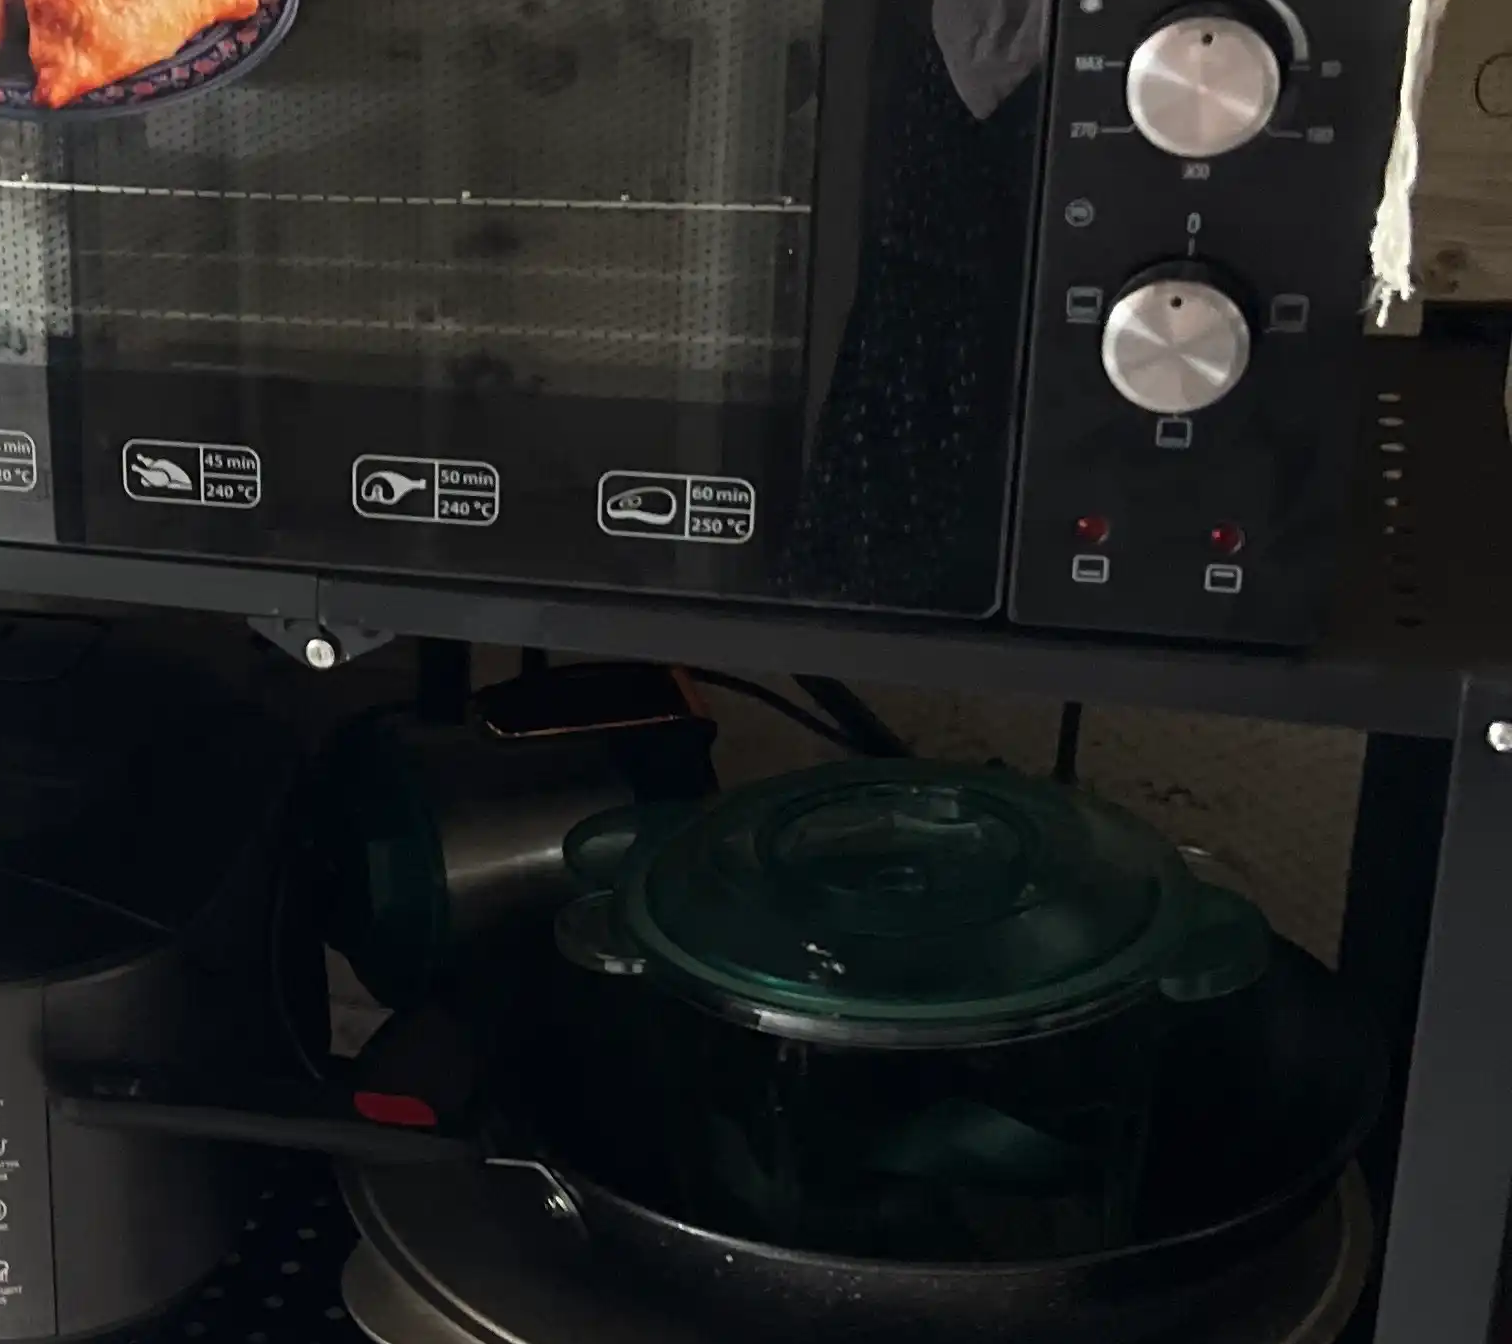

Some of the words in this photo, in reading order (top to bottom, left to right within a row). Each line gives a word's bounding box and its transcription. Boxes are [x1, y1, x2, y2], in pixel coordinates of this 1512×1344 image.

[5, 440, 32, 456] min
[204, 453, 223, 471] 45
[226, 455, 256, 472] min
[440, 469, 461, 486] 50
[462, 471, 494, 487] min
[205, 483, 234, 502] 240
[691, 484, 713, 502] 60
[715, 488, 750, 504] min
[439, 498, 470, 517] 240
[690, 517, 723, 534] 250
